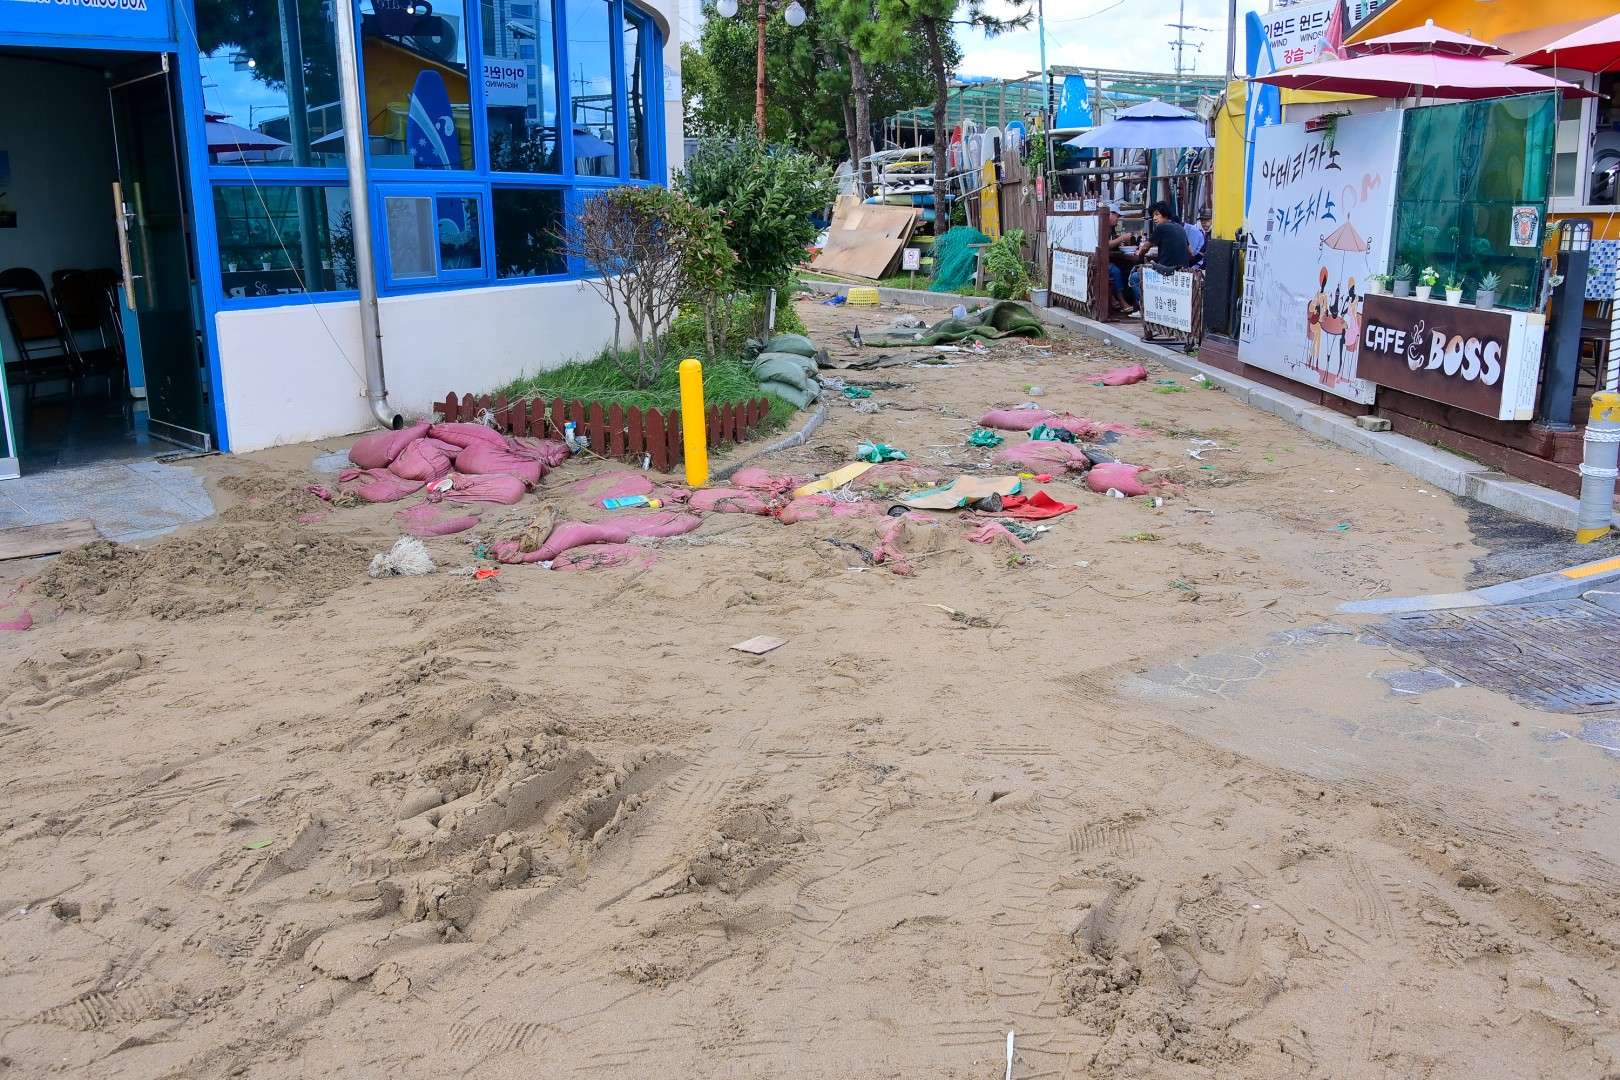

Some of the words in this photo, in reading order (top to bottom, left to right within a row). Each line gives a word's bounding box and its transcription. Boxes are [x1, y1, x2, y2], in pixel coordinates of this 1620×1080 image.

[1263, 18, 1295, 39] 이윈드
[1262, 140, 1342, 190] 아메리카노
[1276, 187, 1337, 238] 카푸치노
[1365, 324, 1407, 355] CAFE
[1424, 328, 1502, 386] BOSS
